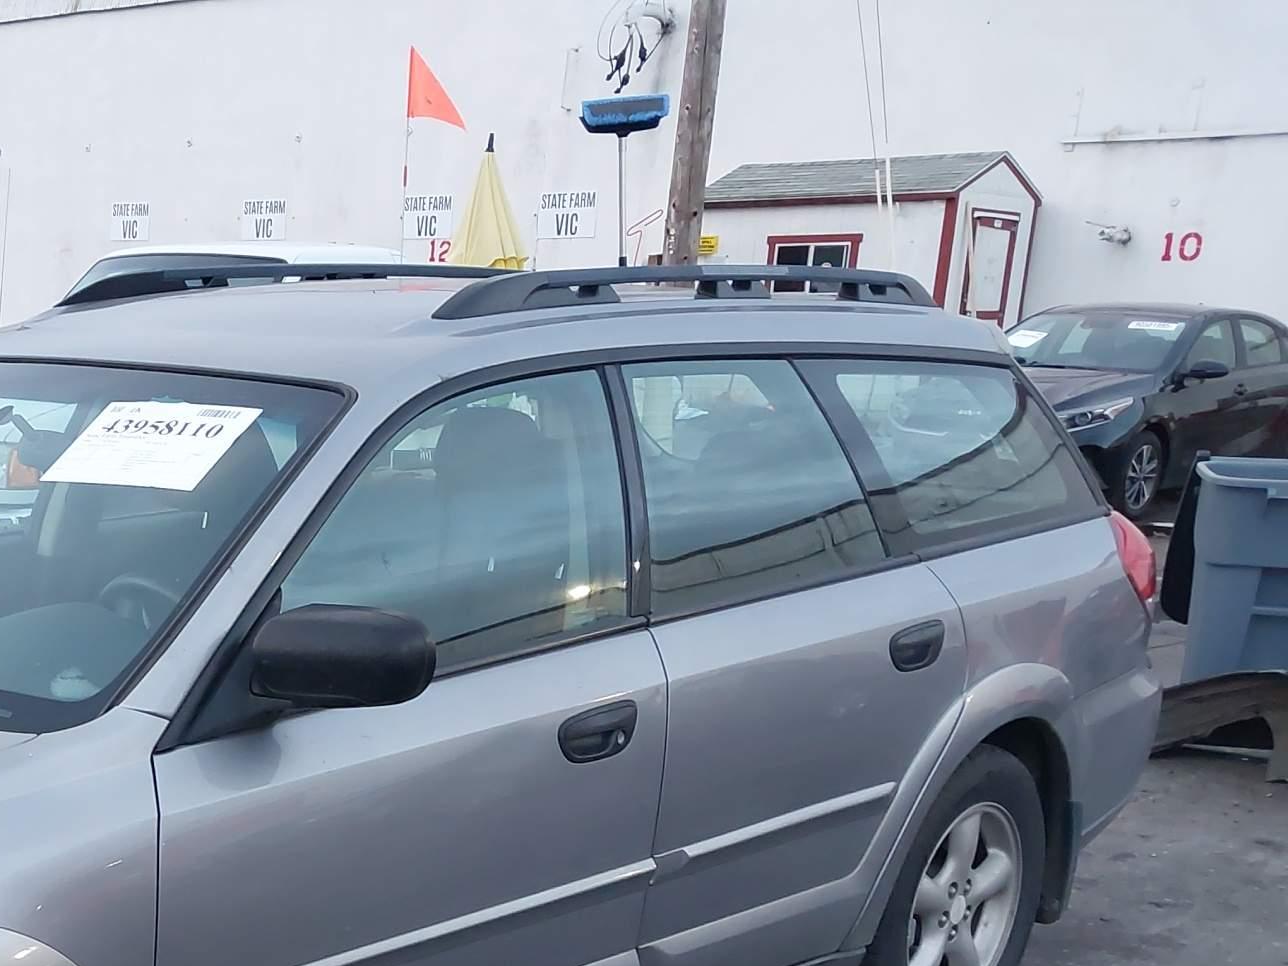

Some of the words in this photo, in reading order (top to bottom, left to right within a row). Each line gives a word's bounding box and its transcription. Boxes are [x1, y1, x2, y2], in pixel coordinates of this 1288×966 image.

[112, 203, 130, 217] STATE
[131, 203, 149, 217] FARM
[244, 201, 264, 215] STATE
[265, 200, 286, 215] FARM
[404, 196, 427, 212] STATE
[428, 195, 452, 211] FARM
[541, 193, 568, 209] STATE
[569, 192, 596, 209] FARM
[122, 219, 138, 239] VIC
[255, 218, 273, 238] VIC
[417, 215, 437, 237] VIC
[555, 213, 579, 236] VIC
[429, 239, 452, 262] 12
[1161, 232, 1202, 261] 10
[102, 418, 225, 439] 43958110
